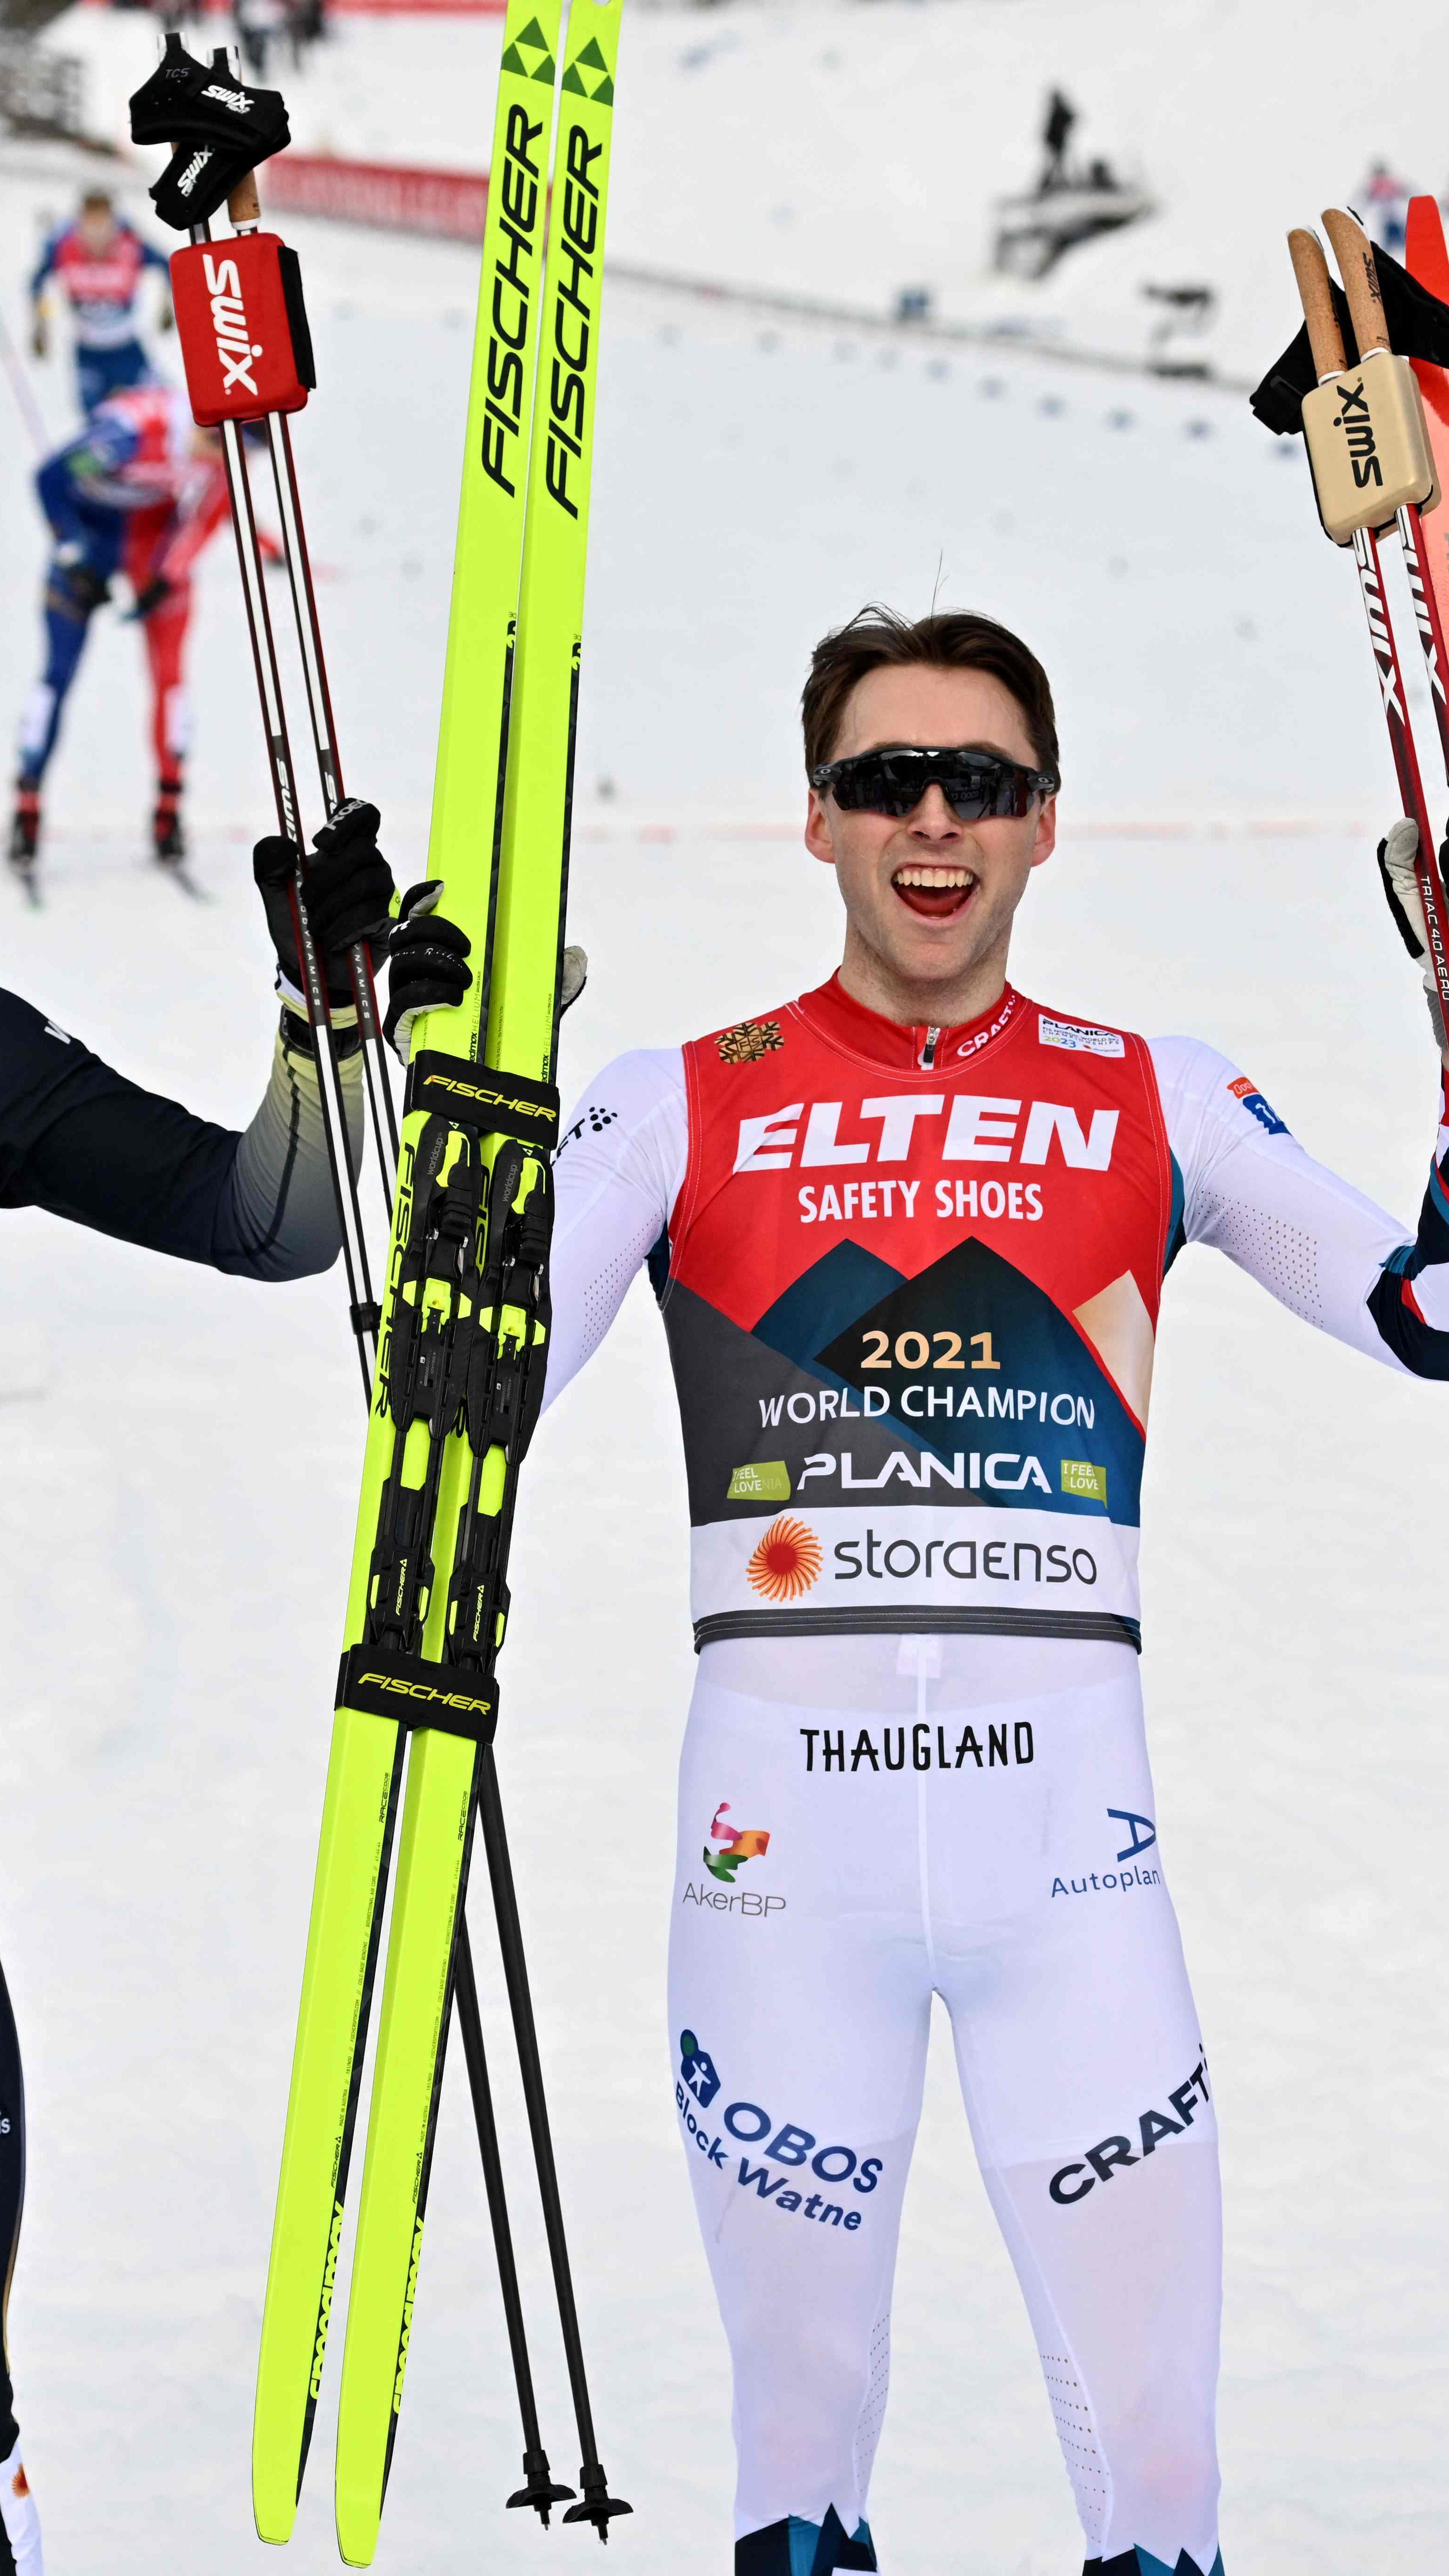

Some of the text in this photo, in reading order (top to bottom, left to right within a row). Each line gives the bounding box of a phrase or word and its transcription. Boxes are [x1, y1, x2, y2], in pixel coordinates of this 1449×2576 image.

[165, 67, 190, 79] TCS
[481, 103, 544, 498] FISCHER
[545, 124, 603, 520] FISCHER
[1421, 876, 1438, 925] TRIAC
[1431, 928, 1443, 951] 4.0
[956, 1005, 1014, 1057] CRAFT
[1042, 1018, 1117, 1038] PLANICA
[1043, 1035, 1076, 1048] 2023
[423, 1075, 557, 1123] FISCHER
[732, 1094, 1120, 1172] ELTEN
[427, 1137, 444, 1176] worldcup
[502, 1164, 519, 1202] worldcup
[798, 1179, 1043, 1223] SAFETY SHOES
[860, 1331, 1001, 1370] 2021
[759, 1385, 1095, 1430] WORLD CHAMPION
[737, 1467, 758, 1480] FEEL
[797, 1451, 1052, 1494] PLANICA
[1063, 1463, 1068, 1474] I
[394, 1565, 406, 1617] FISCHER
[472, 1592, 484, 1642] FISCHER
[357, 1672, 491, 1716] FISCHER
[799, 1721, 1034, 1773] THAUGLAND
[1050, 1865, 1161, 1898] Autoplan
[350, 1999, 360, 2042] FISCHERSPORTS.COM
[366, 1897, 374, 1928] BIDIRECTIONAL
[430, 2016, 440, 2059] FISCHERSPORTS.COM
[445, 1915, 454, 1945] BIDIRECTIONAL
[723, 2101, 884, 2194] OBOS
[1048, 2060, 1209, 2205] CRAFT
[330, 2142, 342, 2188] FISCHER
[675, 2080, 863, 2232] Block Watne
[411, 2160, 423, 2204] FISCHER
